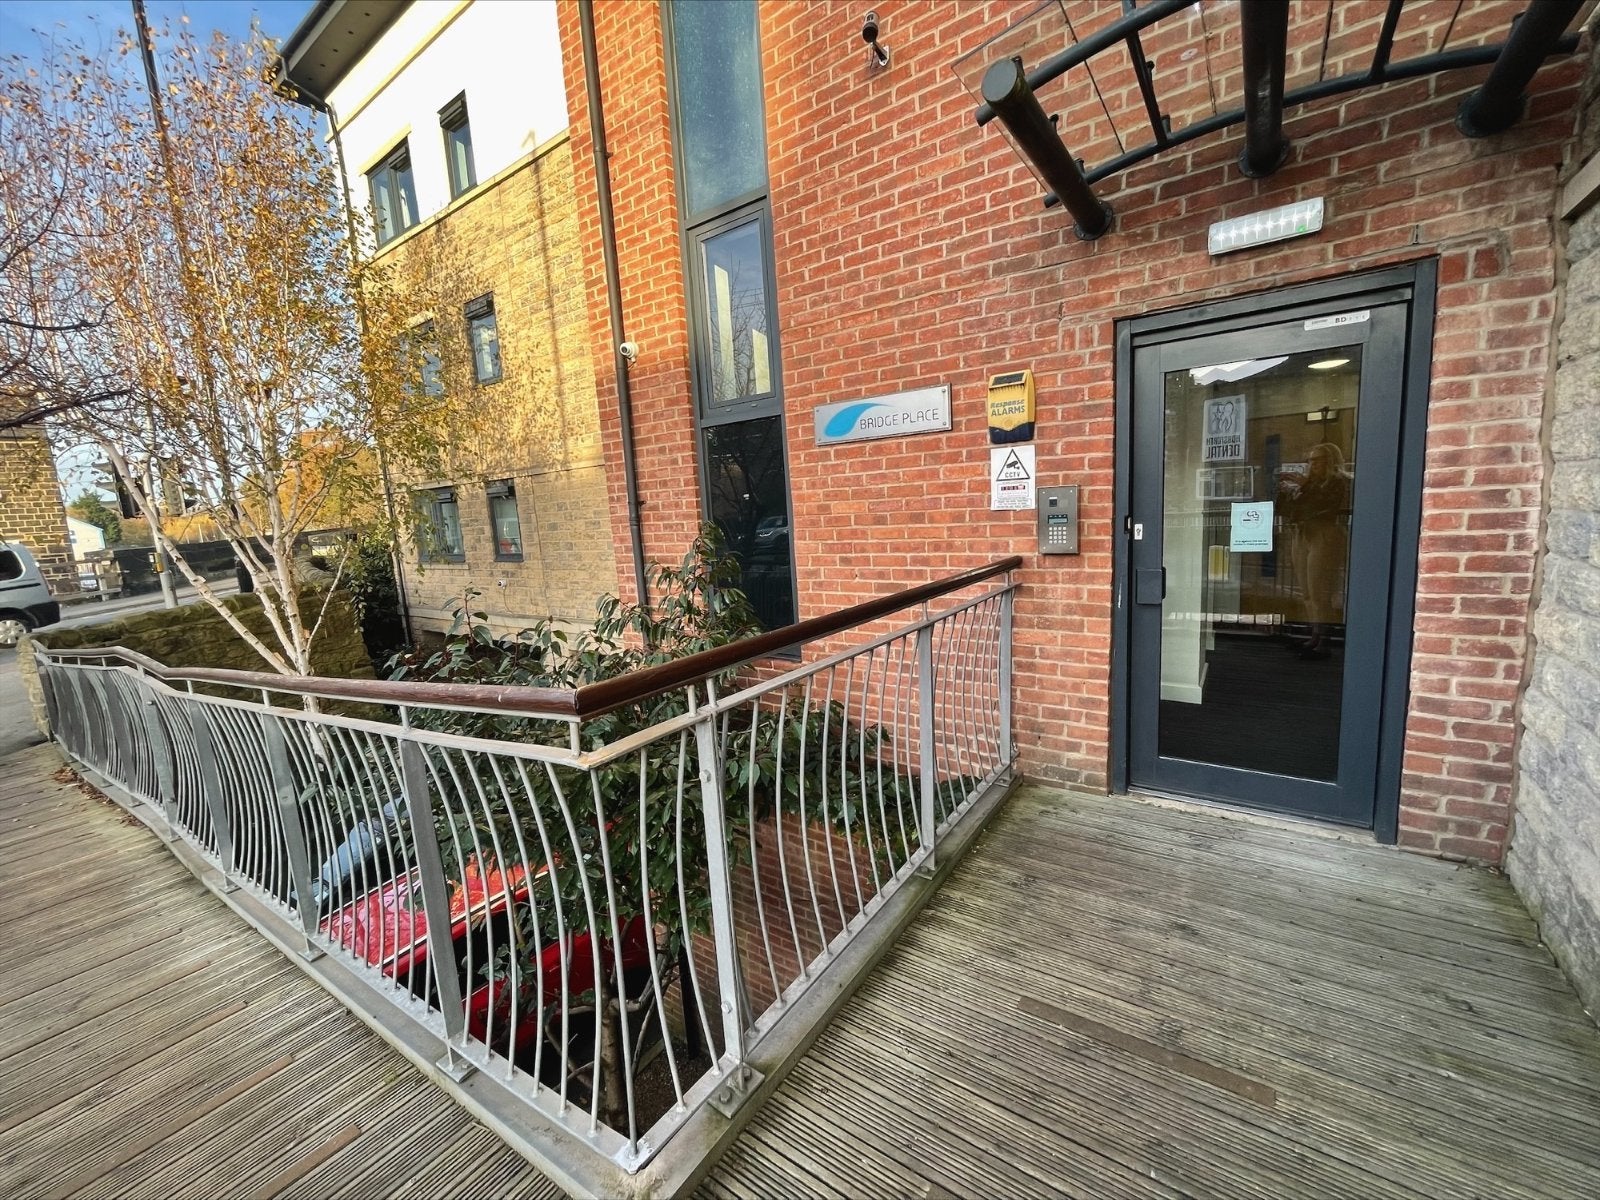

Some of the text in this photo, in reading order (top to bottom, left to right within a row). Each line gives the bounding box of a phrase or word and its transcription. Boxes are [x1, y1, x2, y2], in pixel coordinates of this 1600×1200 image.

[990, 398, 1025, 409] Response
[990, 405, 1026, 417] ALARMS
[860, 408, 940, 430] BRIDGE PLACE
[1004, 471, 1021, 479] CCTV
